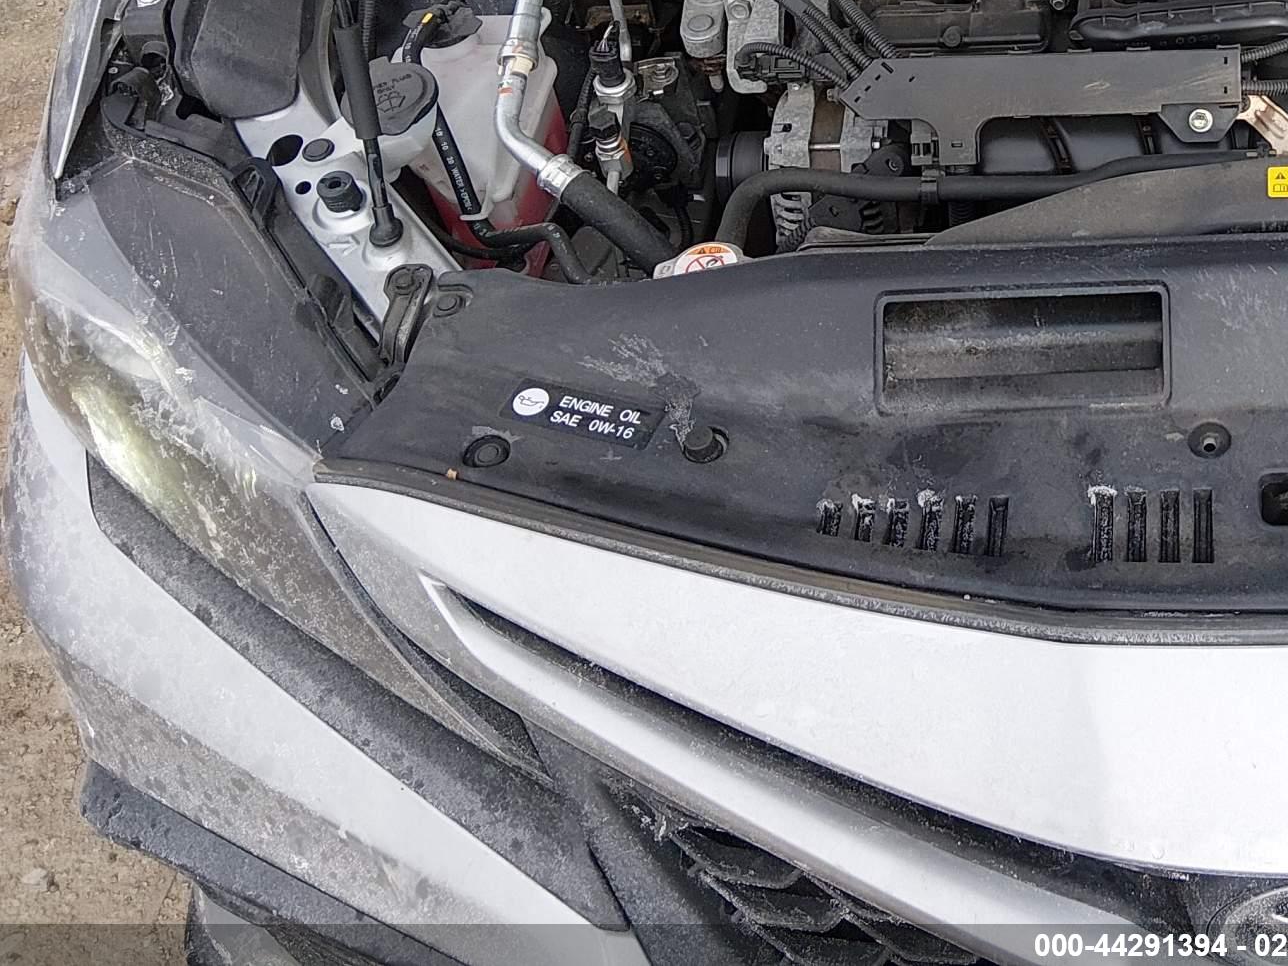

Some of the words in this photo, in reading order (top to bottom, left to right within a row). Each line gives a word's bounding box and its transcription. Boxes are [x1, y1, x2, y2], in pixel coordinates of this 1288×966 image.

[550, 410, 582, 427] SAE
[588, 419, 635, 440] 0W-16
[558, 396, 614, 417] ENGINE
[619, 409, 642, 425] OIL
